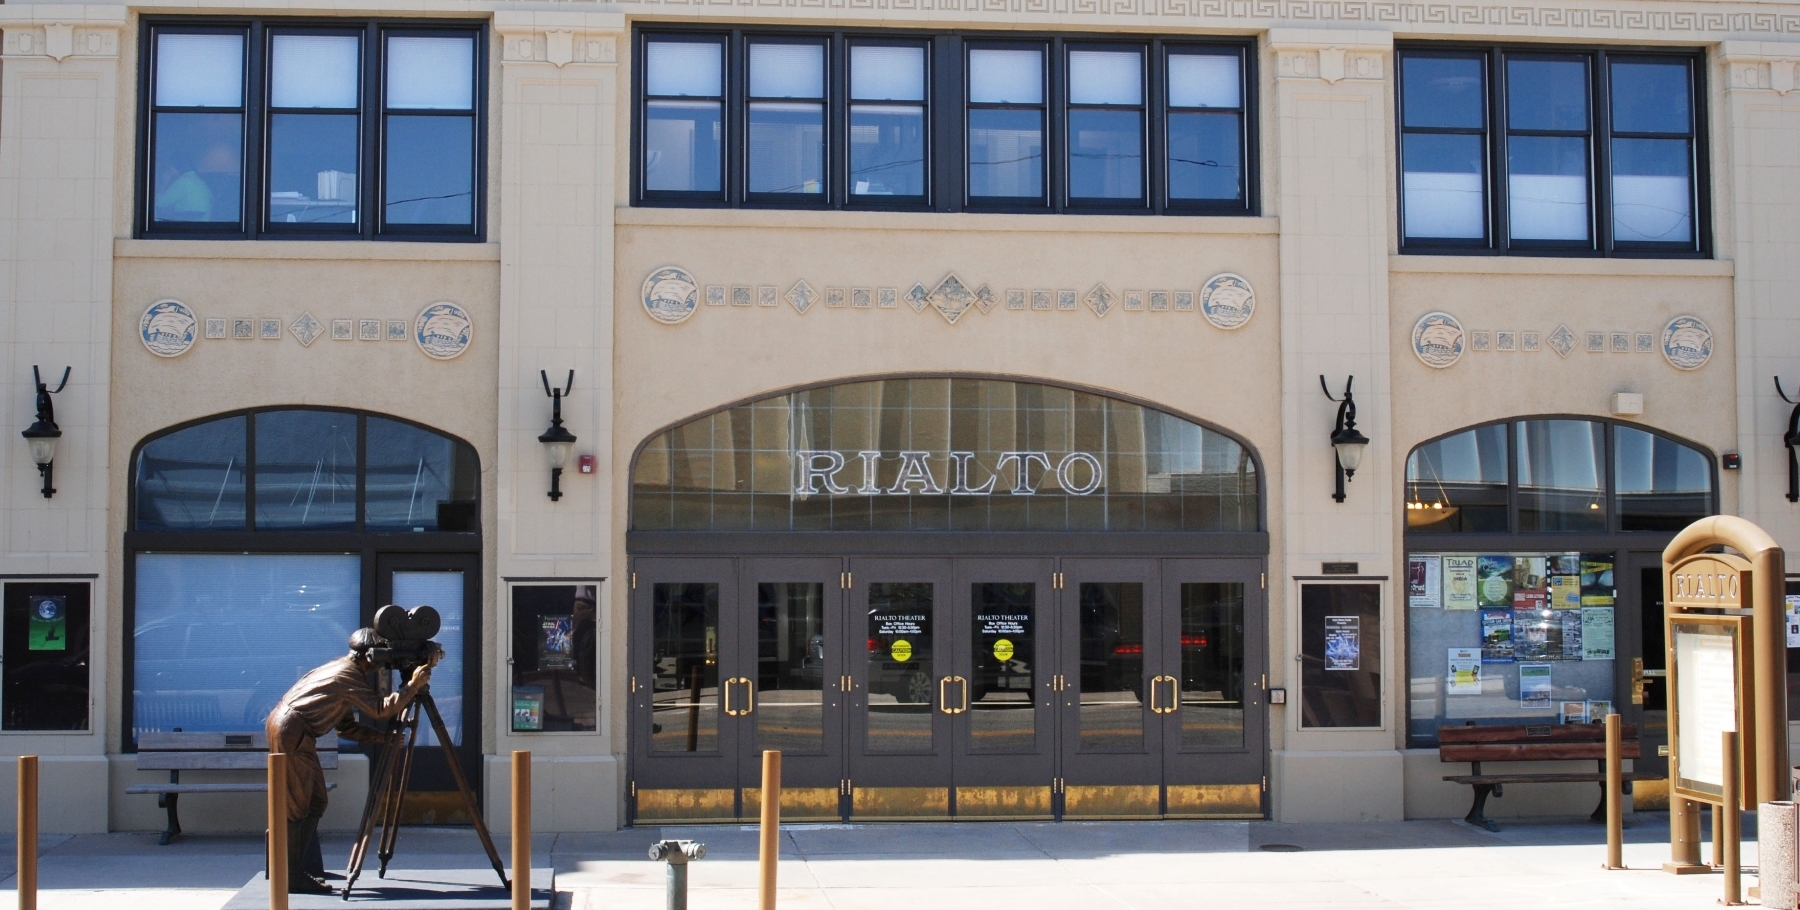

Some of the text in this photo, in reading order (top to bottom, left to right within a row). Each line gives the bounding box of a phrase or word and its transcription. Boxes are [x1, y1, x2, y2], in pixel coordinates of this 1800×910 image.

[796, 451, 1102, 496] RIALTO
[1446, 558, 1474, 566] TRIAD
[1676, 574, 1738, 599] RIALTO
